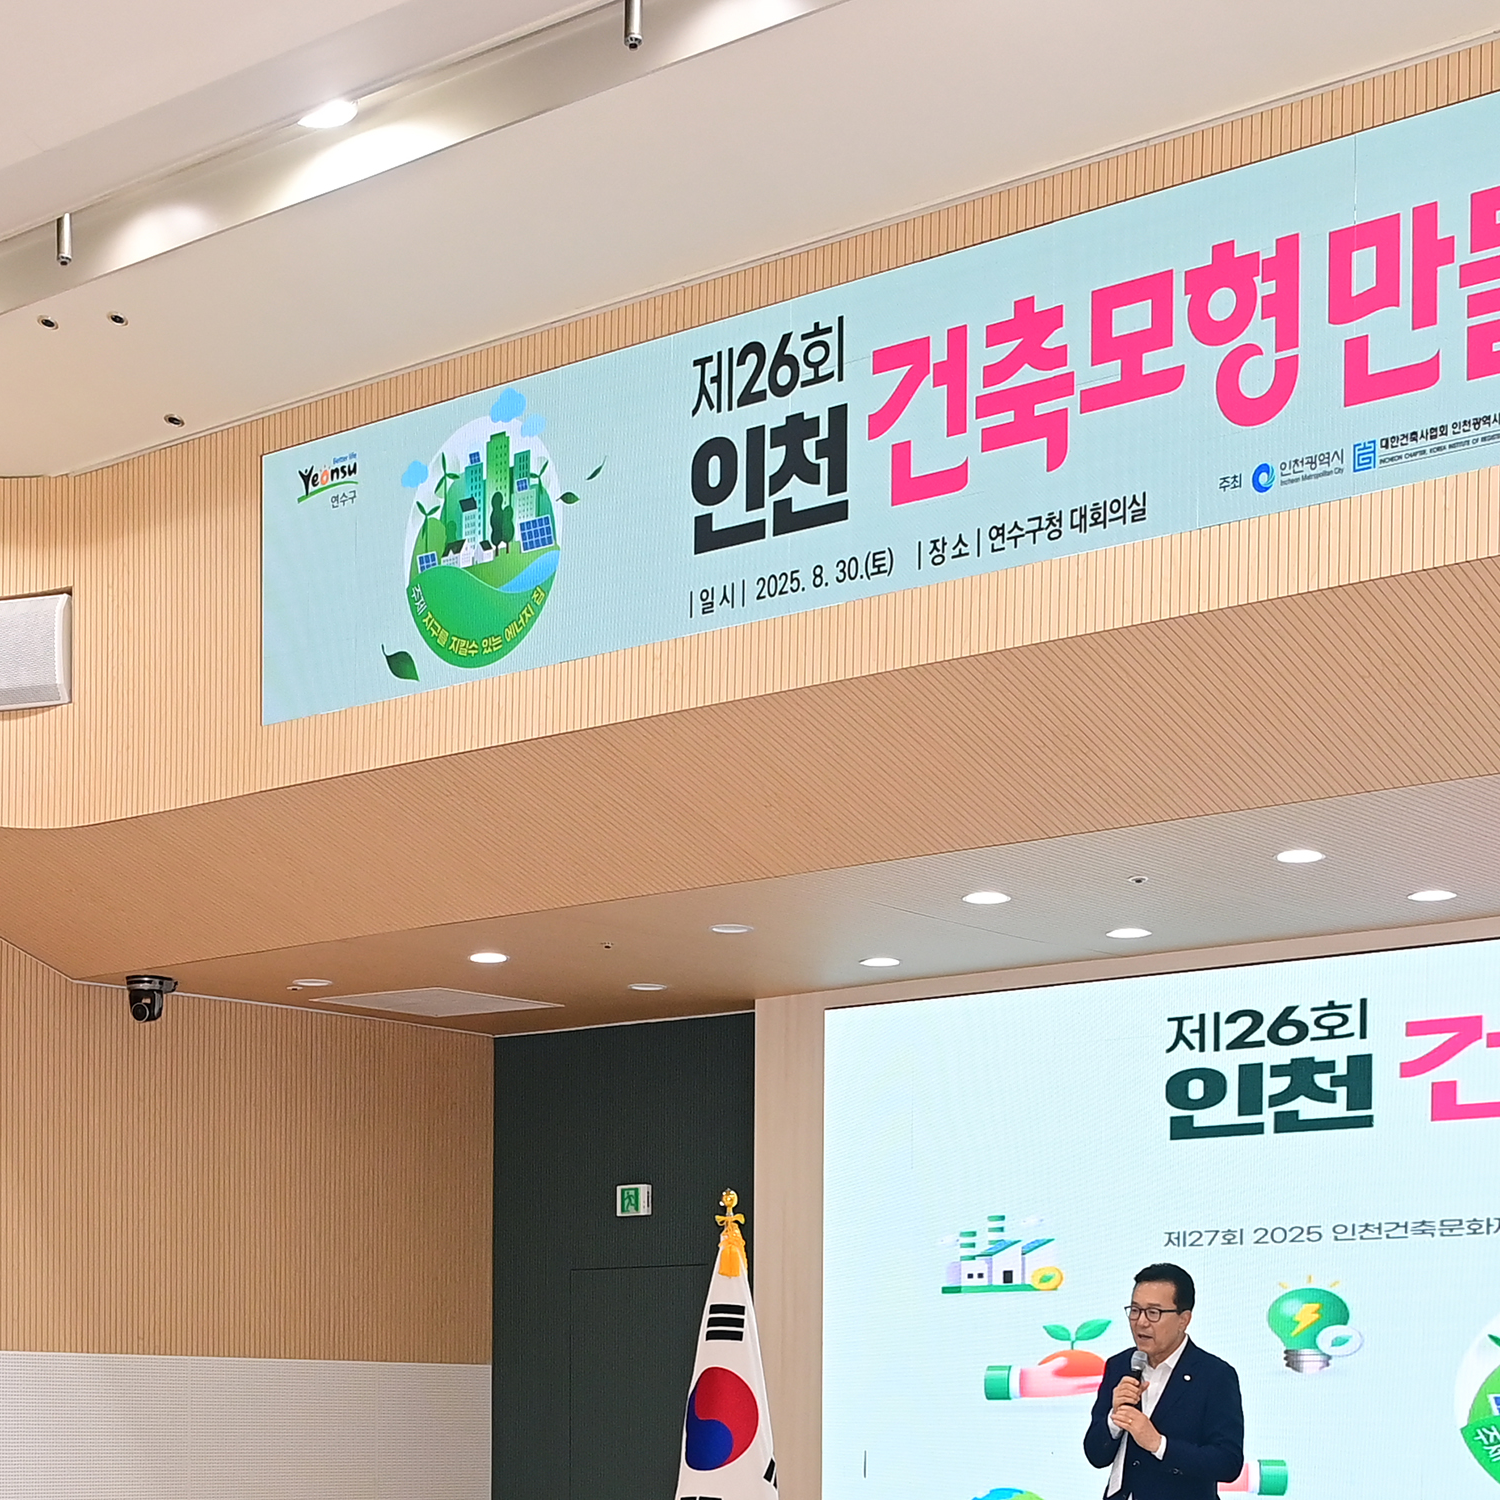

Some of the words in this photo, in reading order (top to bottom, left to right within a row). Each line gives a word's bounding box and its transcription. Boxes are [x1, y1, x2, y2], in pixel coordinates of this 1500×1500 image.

[691, 315, 844, 417] 제26회
[691, 402, 849, 555] 인천
[867, 232, 1301, 507] 건축모형
[1379, 423, 1449, 450] 대한건축사협회
[297, 461, 358, 497] Yeonsu
[1218, 472, 1243, 493] 주최
[1279, 447, 1345, 478] 인천광역시
[330, 489, 357, 509] 연수구
[755, 569, 806, 601] 2025.
[811, 564, 830, 590] 8.
[834, 546, 895, 584] 30.(토)
[987, 509, 1063, 555] 연수구청
[1069, 491, 1148, 536] 대회의실
[422, 611, 450, 648] 지구를
[481, 634, 504, 655] 있는
[504, 603, 535, 642] 에너지
[1164, 997, 1369, 1054] 제26회
[1164, 1052, 1375, 1141] 인천
[1163, 1227, 1245, 1249] 제27회
[1253, 1225, 1323, 1246] 2025
